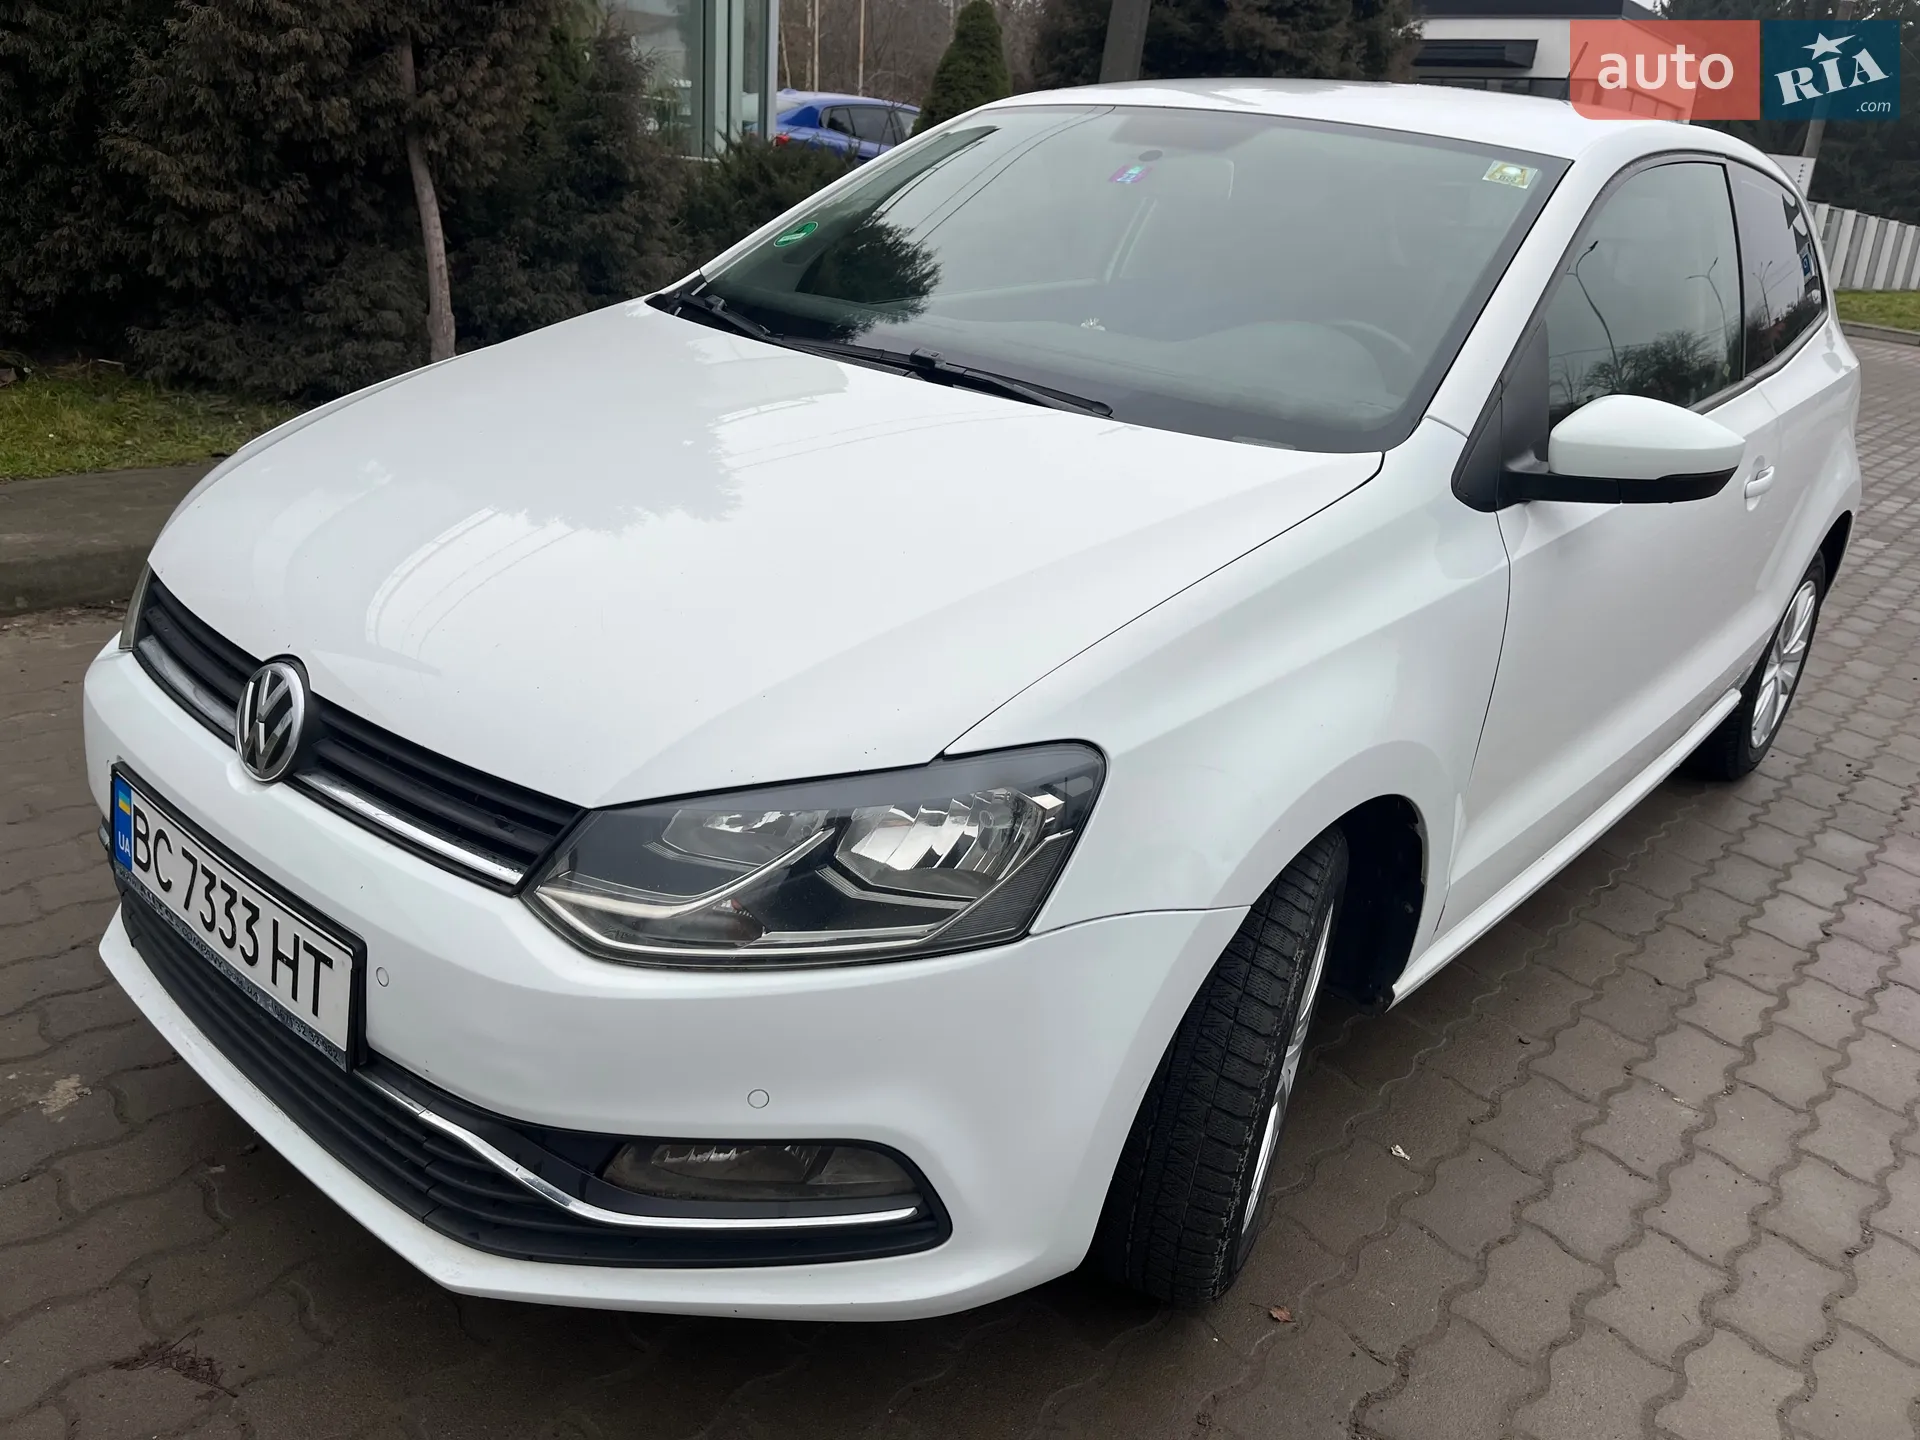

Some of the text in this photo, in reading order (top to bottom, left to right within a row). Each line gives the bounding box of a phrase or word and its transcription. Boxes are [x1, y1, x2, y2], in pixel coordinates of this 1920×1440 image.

[118, 831, 132, 858] UA
[133, 804, 334, 1018] BC 7333 HT
